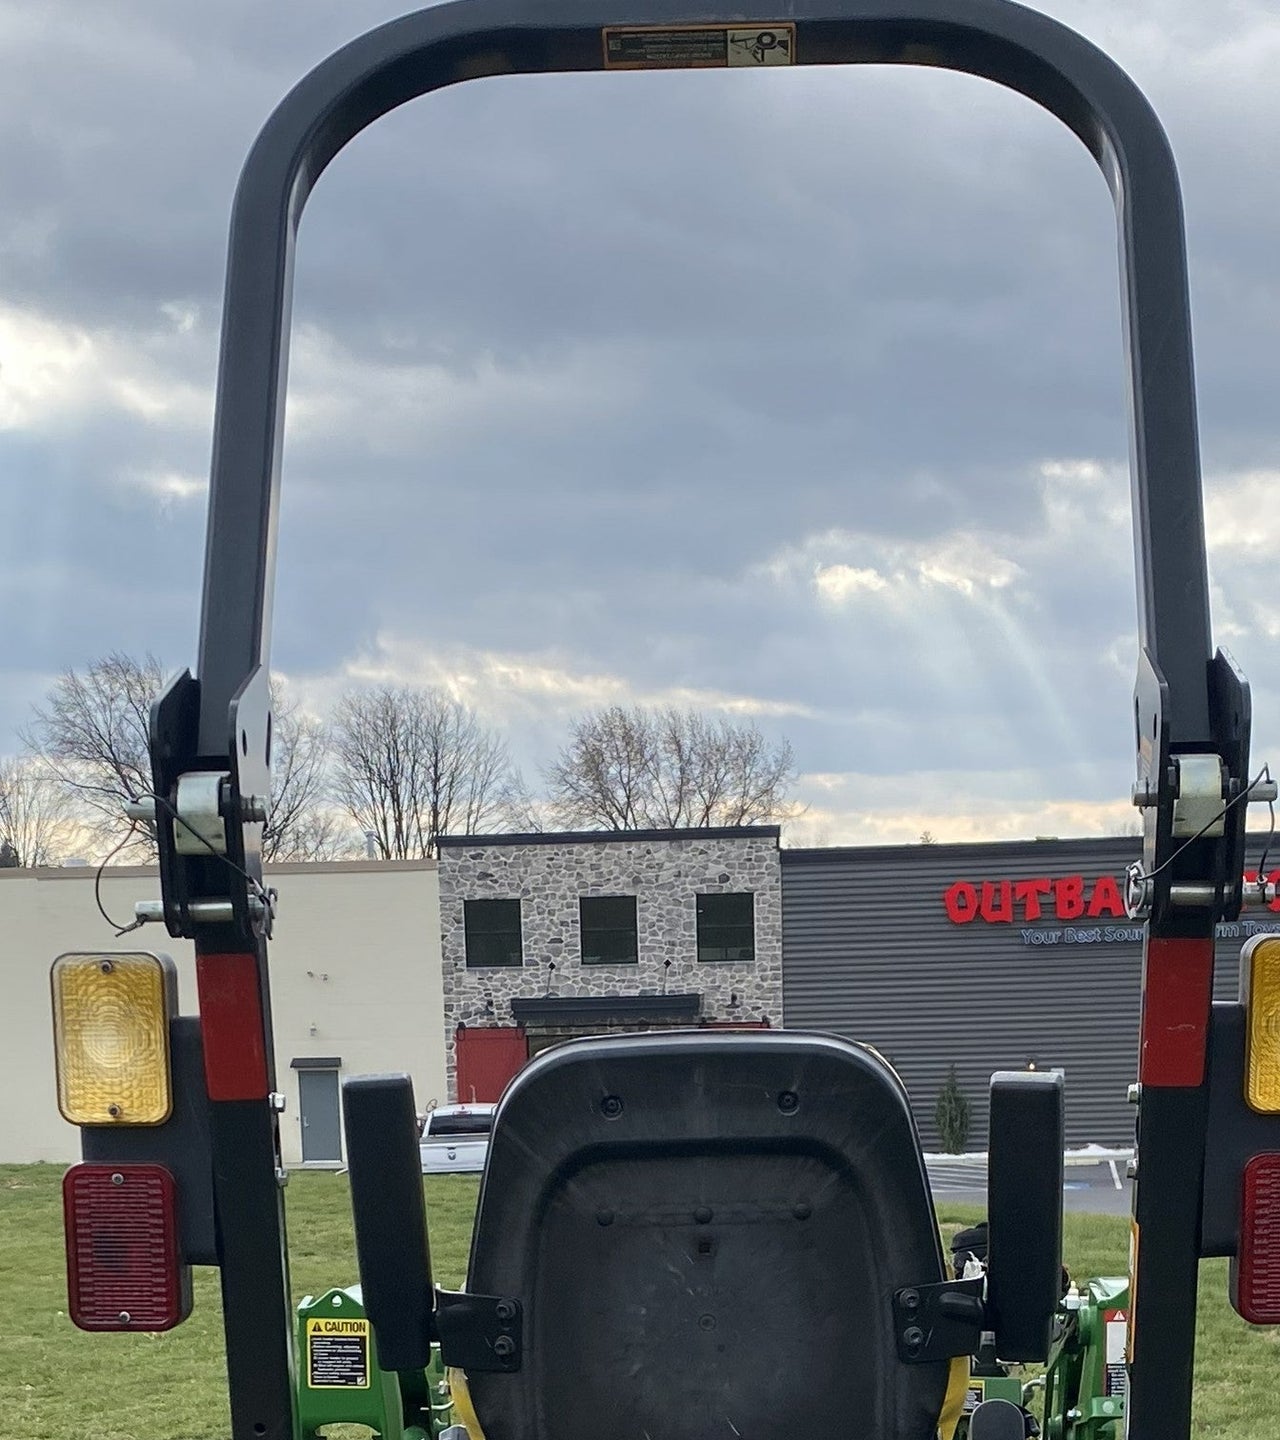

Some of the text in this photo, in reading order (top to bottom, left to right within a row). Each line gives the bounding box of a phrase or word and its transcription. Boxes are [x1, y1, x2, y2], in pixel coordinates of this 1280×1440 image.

[944, 875, 1126, 924] OUTBA
[1021, 928, 1061, 945] Your
[1064, 927, 1101, 944] Best
[1104, 926, 1146, 942] Sour
[324, 1321, 366, 1333] CAUTION
